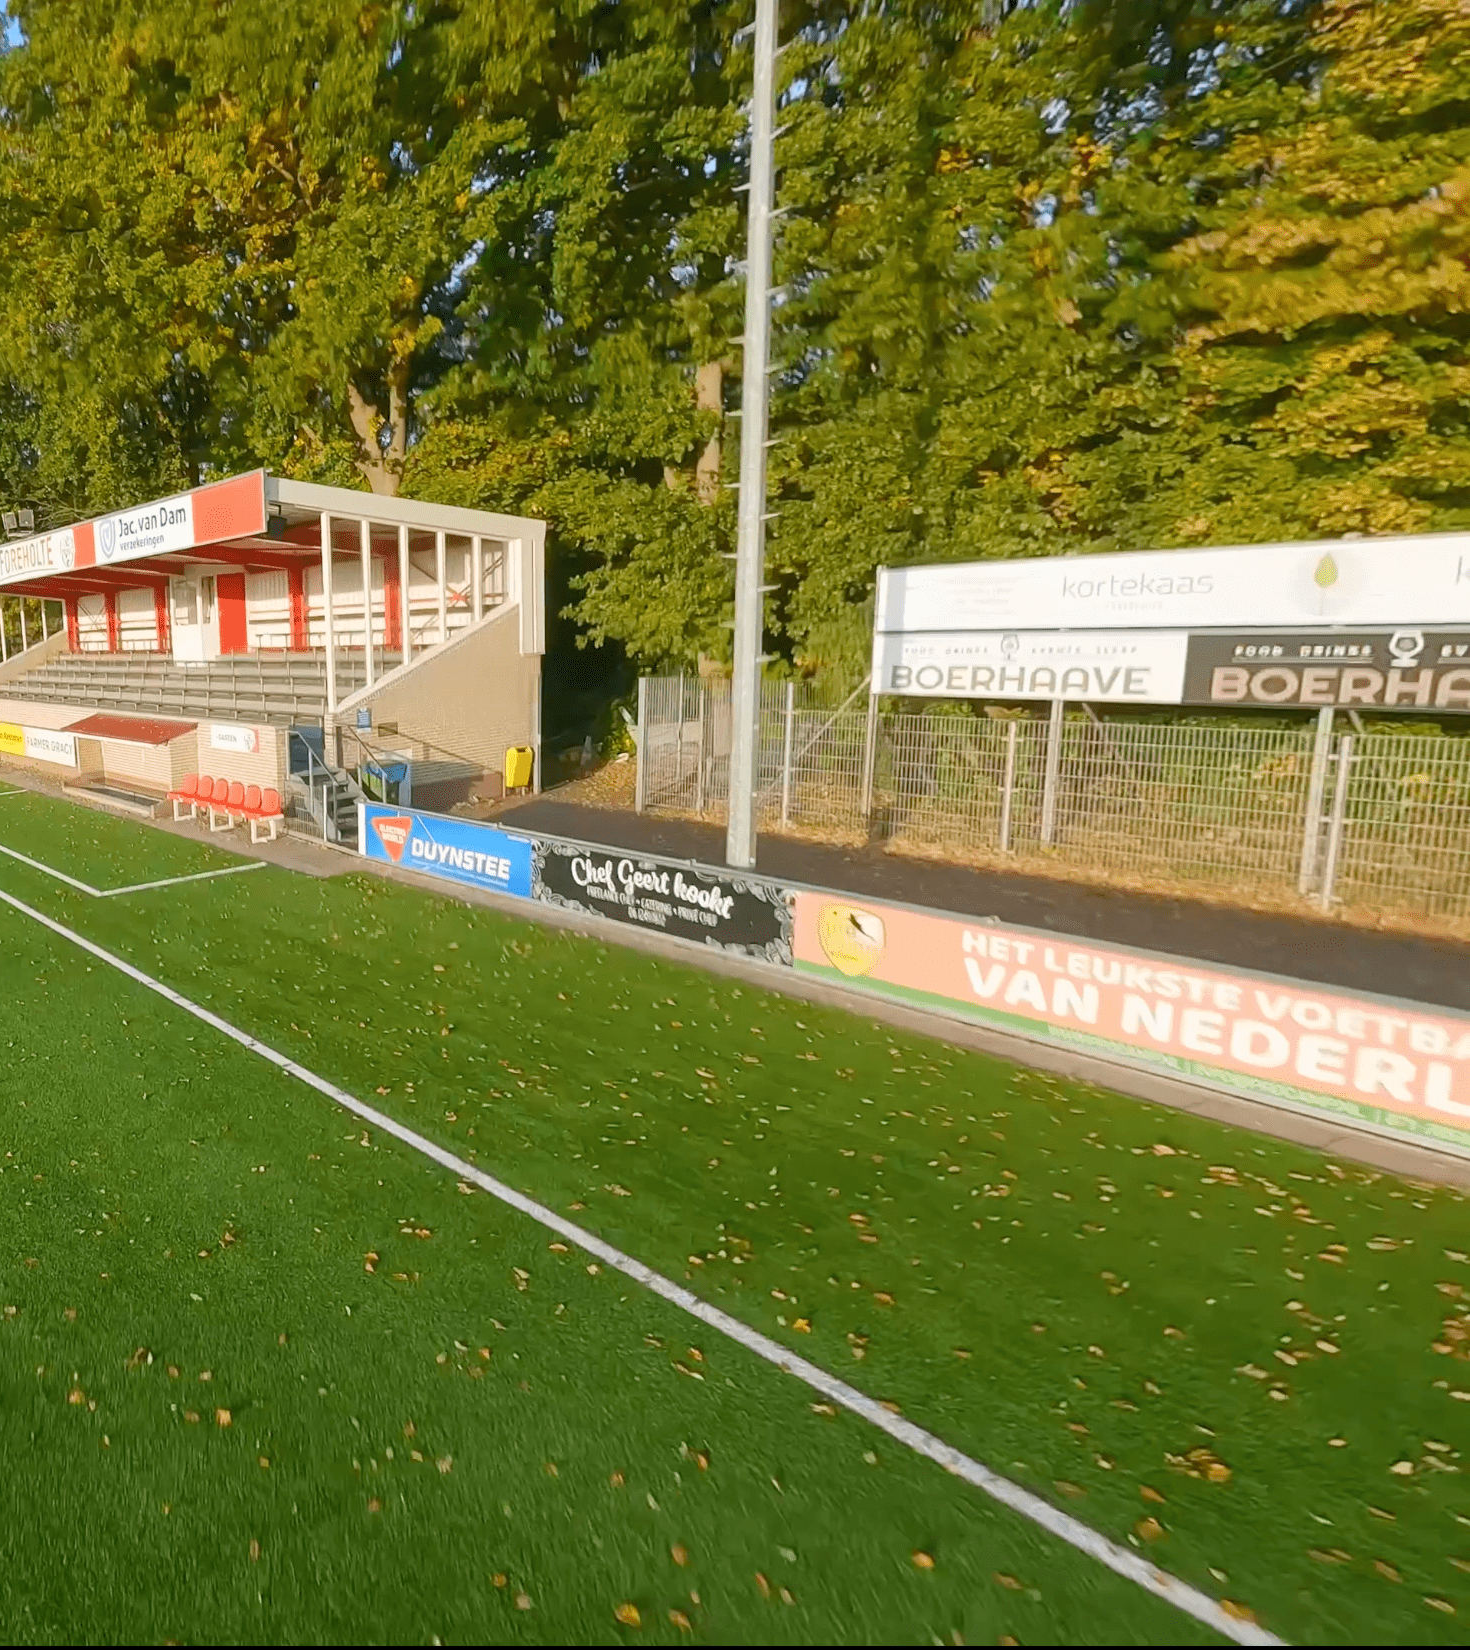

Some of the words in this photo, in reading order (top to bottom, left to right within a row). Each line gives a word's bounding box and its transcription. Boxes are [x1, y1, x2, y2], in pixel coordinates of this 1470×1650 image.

[119, 518, 138, 538] Jac.
[138, 513, 157, 532] van
[160, 506, 187, 528] Dam
[119, 534, 165, 552] verzekeringen
[1061, 571, 1215, 599] kortekaas
[890, 664, 1152, 695] BOERHAAVE
[26, 736, 50, 751] FARMER
[50, 739, 74, 756] GRACY
[411, 837, 512, 881] DUYNSTEE
[571, 856, 616, 893] Chef
[617, 858, 671, 896] Geert
[673, 871, 735, 920] kookt
[961, 929, 1035, 965] HET
[1043, 947, 1243, 1011] LEUKSTE
[963, 956, 1101, 1025] VAN
[1120, 992, 1470, 1118] NEDERL
